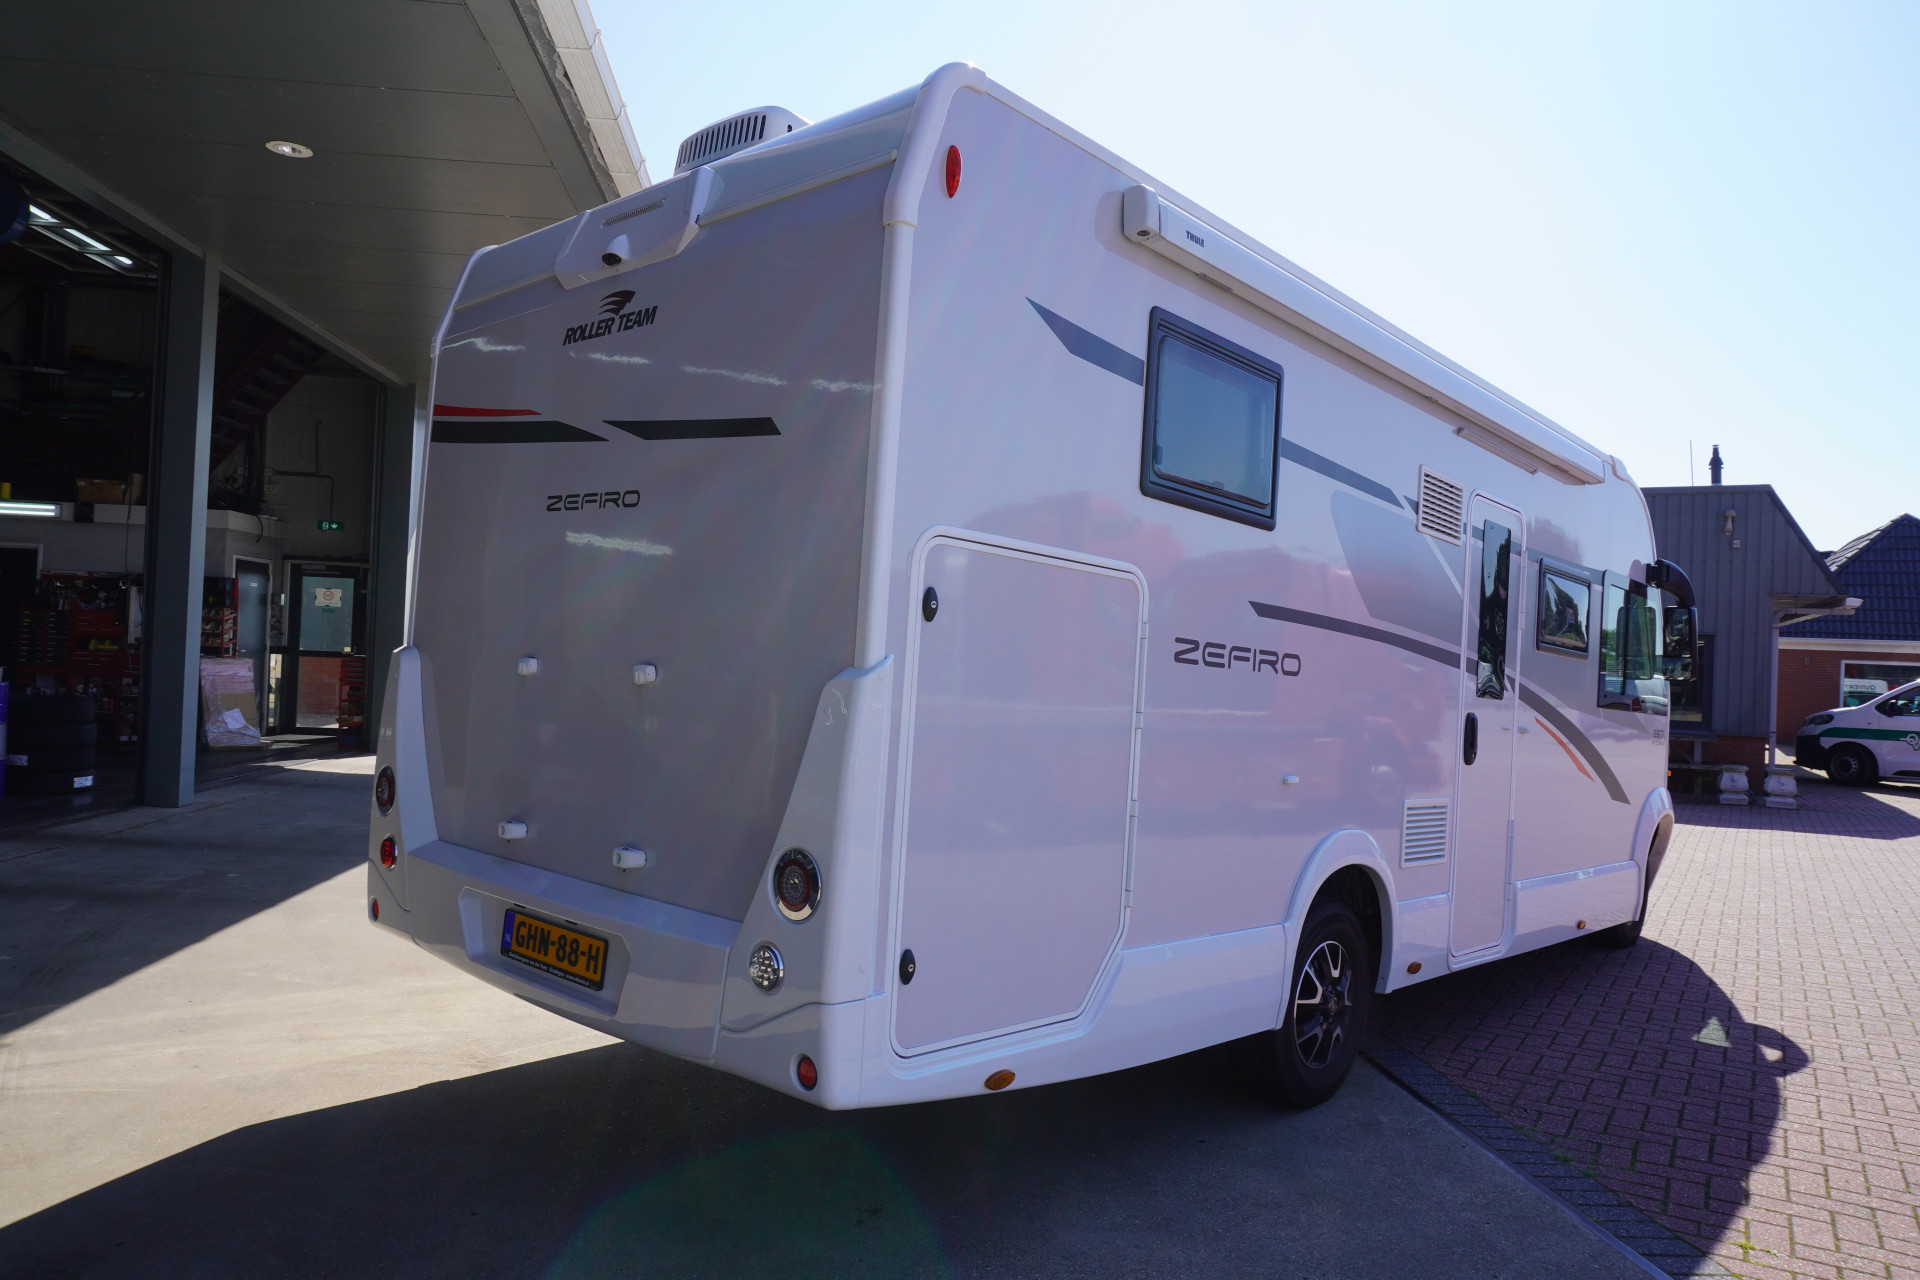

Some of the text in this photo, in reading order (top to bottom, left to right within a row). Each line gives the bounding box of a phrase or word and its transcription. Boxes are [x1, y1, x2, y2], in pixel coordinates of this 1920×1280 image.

[1185, 229, 1205, 248] THULE
[562, 305, 658, 346] ROLLER TEAM
[546, 489, 641, 512] ZEFIRO
[1173, 636, 1302, 677] ZEFIRO
[515, 920, 601, 975] GHN-88-H
